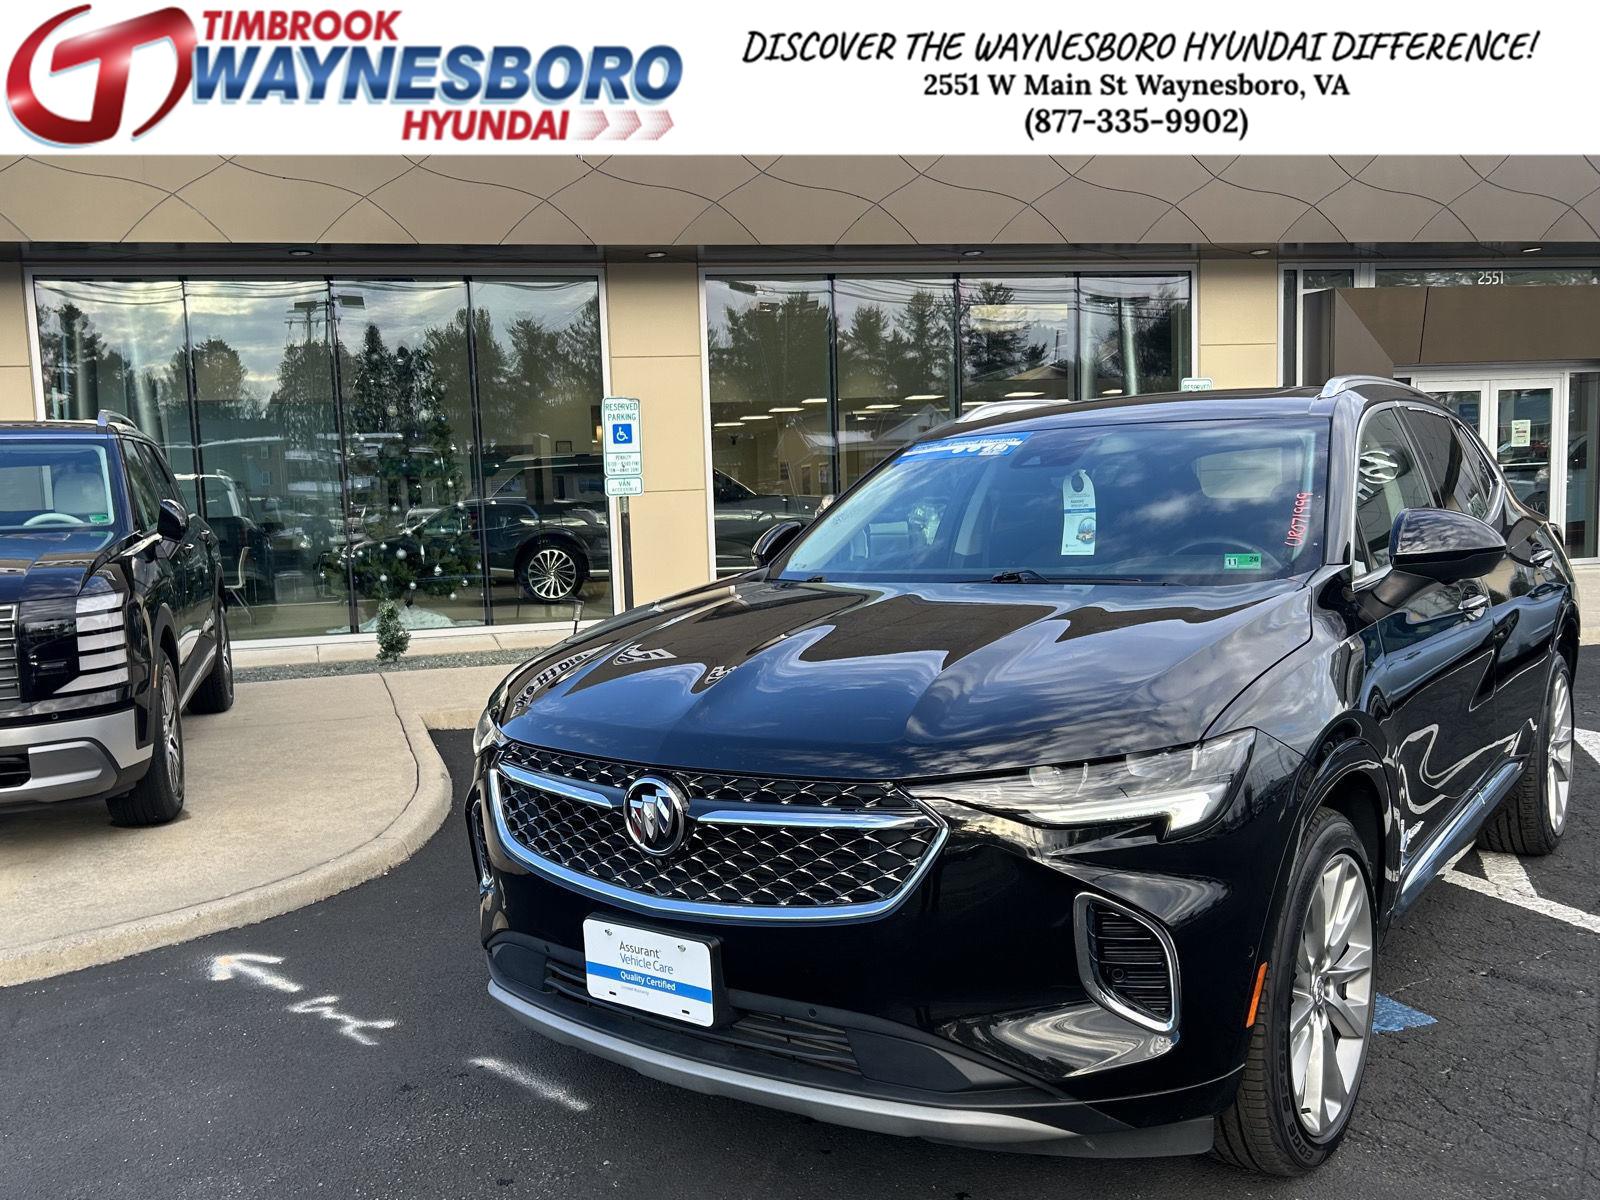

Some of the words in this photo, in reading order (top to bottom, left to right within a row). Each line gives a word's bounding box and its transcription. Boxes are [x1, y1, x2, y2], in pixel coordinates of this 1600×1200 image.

[1477, 271, 1504, 285] 2551
[605, 402, 638, 411] RESERVED
[608, 413, 636, 421] PARKING
[1227, 558, 1237, 566] 11
[619, 940, 660, 959] Assurant
[619, 952, 651, 971] Vehicle
[653, 960, 674, 975] Care
[620, 971, 645, 986] Quality
[646, 976, 676, 991] Certified
